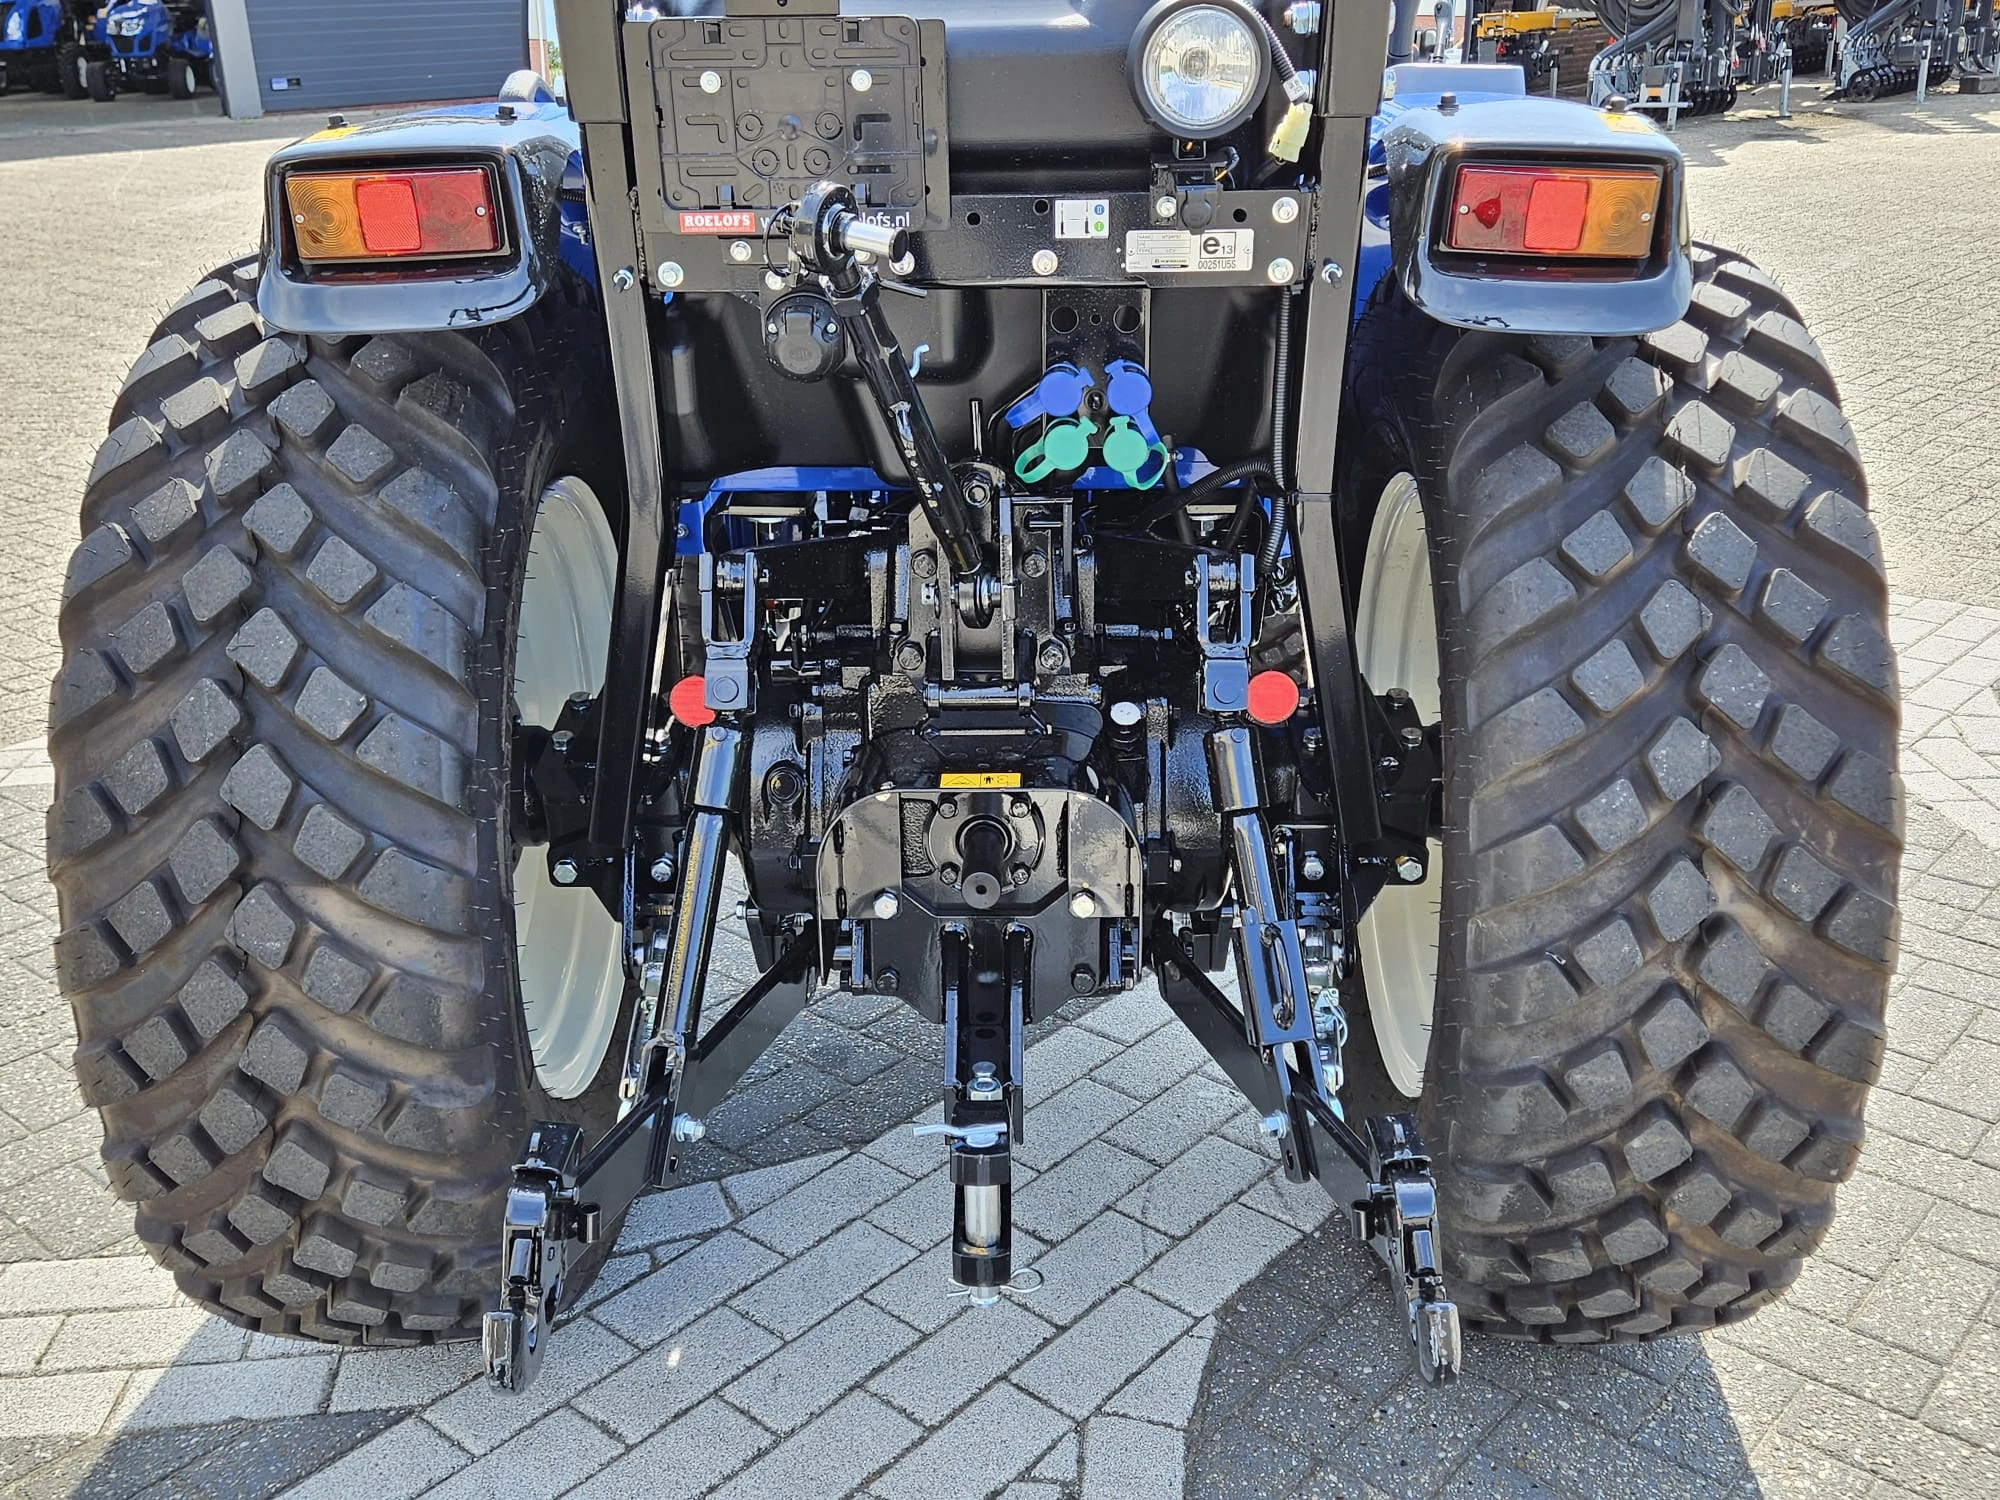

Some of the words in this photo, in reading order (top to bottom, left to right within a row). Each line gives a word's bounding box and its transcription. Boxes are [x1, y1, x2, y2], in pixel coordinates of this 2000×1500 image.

[684, 214, 751, 227] ROELOFS
[858, 211, 910, 228] lofs.nl
[1202, 236, 1221, 255] e
[1221, 245, 1233, 255] 13
